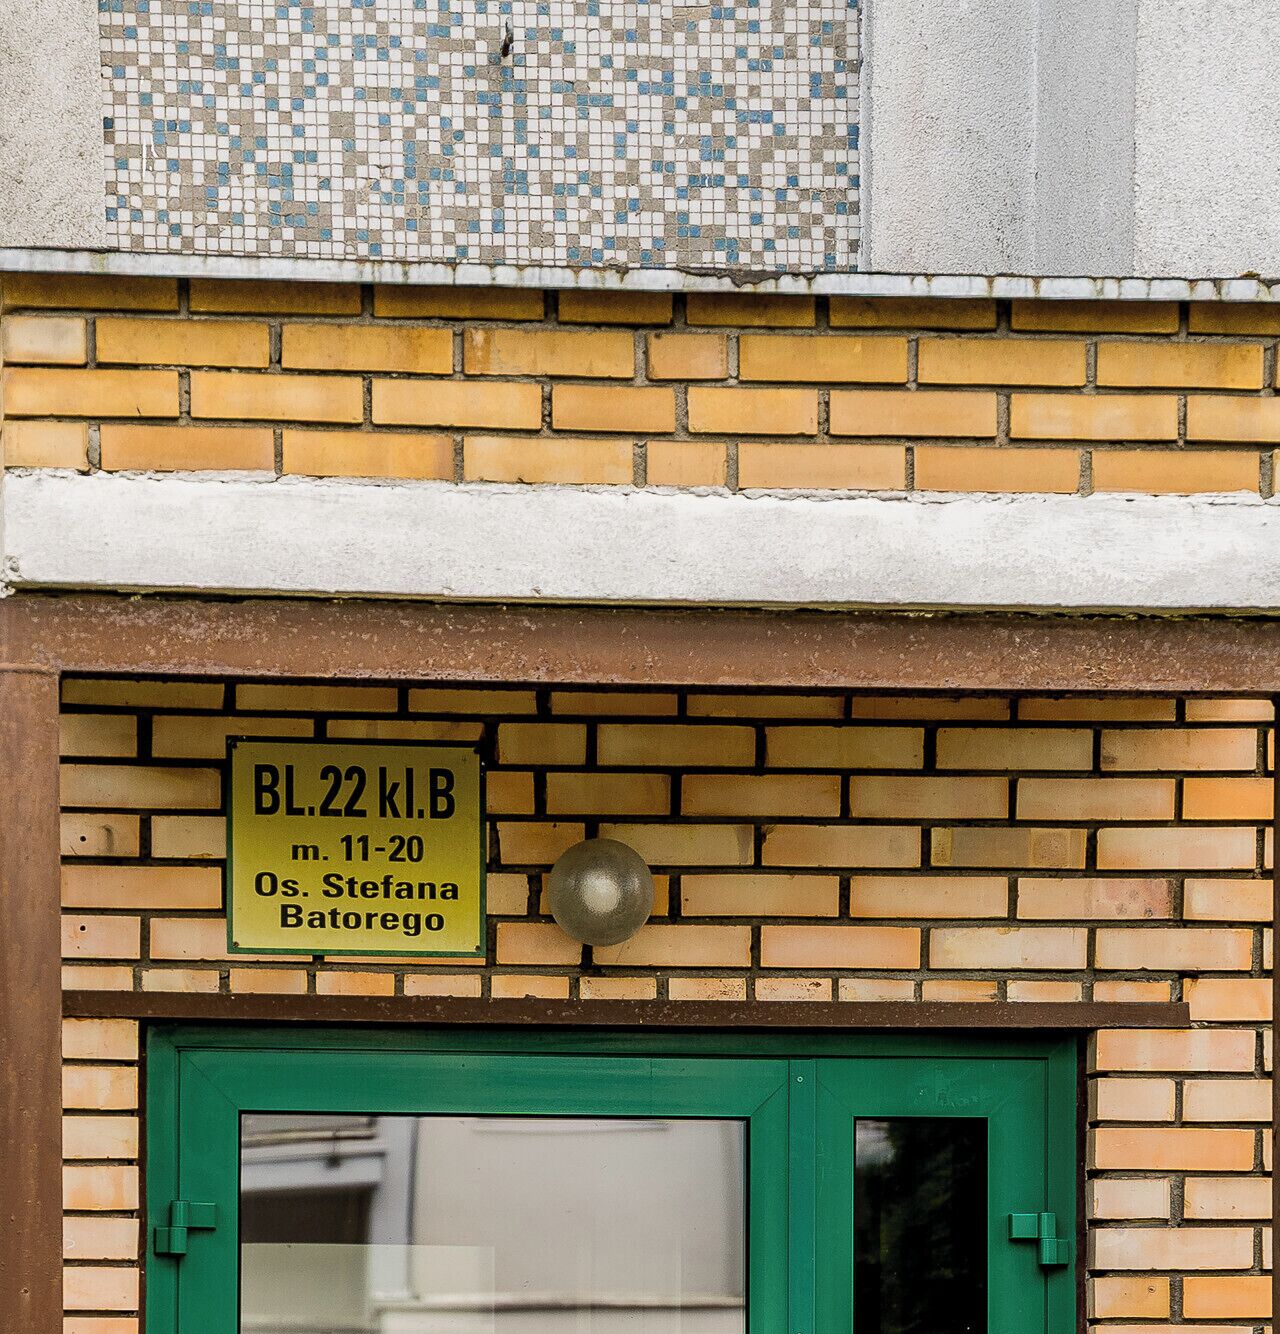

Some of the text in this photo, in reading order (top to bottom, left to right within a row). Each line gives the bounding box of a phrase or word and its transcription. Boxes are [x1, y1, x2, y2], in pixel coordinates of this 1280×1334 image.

[254, 764, 456, 819] BL.22 kl.B
[291, 834, 424, 863] m. 11-20
[254, 871, 459, 900] Os. Stefana
[280, 903, 445, 936] Batorego
